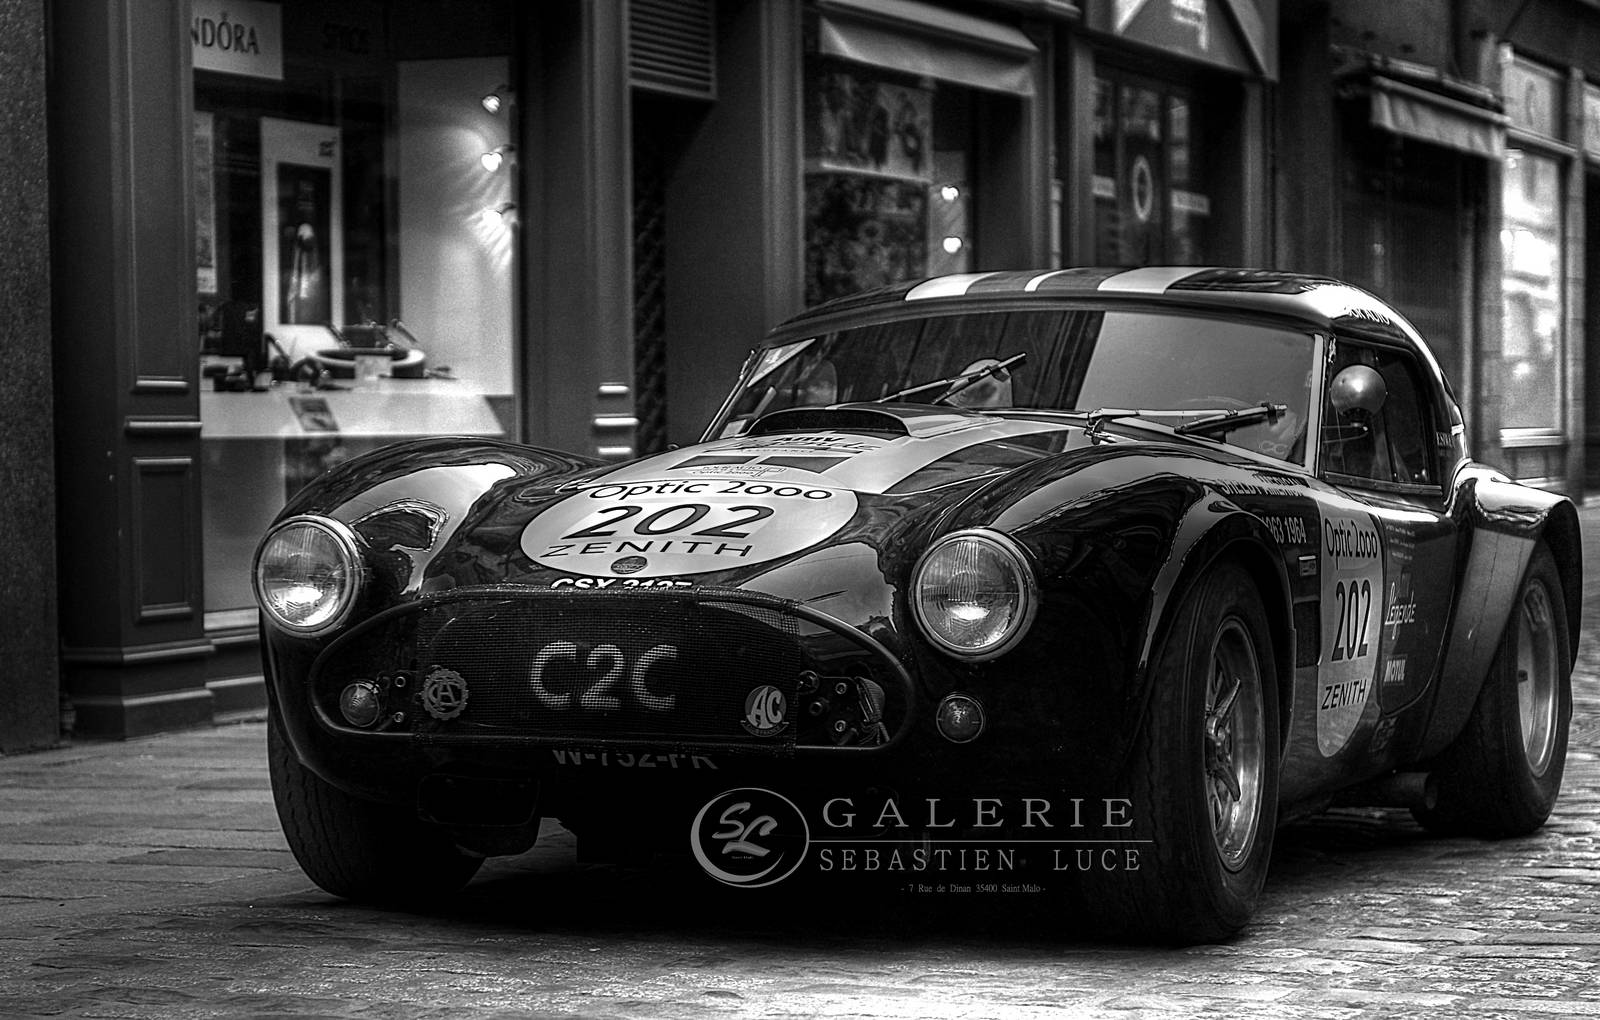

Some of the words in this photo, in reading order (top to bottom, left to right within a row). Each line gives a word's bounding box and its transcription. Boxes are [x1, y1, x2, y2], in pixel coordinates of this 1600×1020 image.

[589, 480, 706, 501] Optic
[719, 481, 833, 500] 2000
[561, 503, 775, 540] 202
[1262, 515, 1285, 544] 963
[1284, 515, 1307, 544] 1964
[539, 540, 752, 557] ZENITH
[1324, 518, 1353, 570] Optic
[1351, 519, 1378, 559] 2000
[1331, 579, 1371, 661] 202
[530, 640, 681, 711] C2C
[746, 686, 783, 730] AC
[1321, 679, 1367, 710] ZENITH
